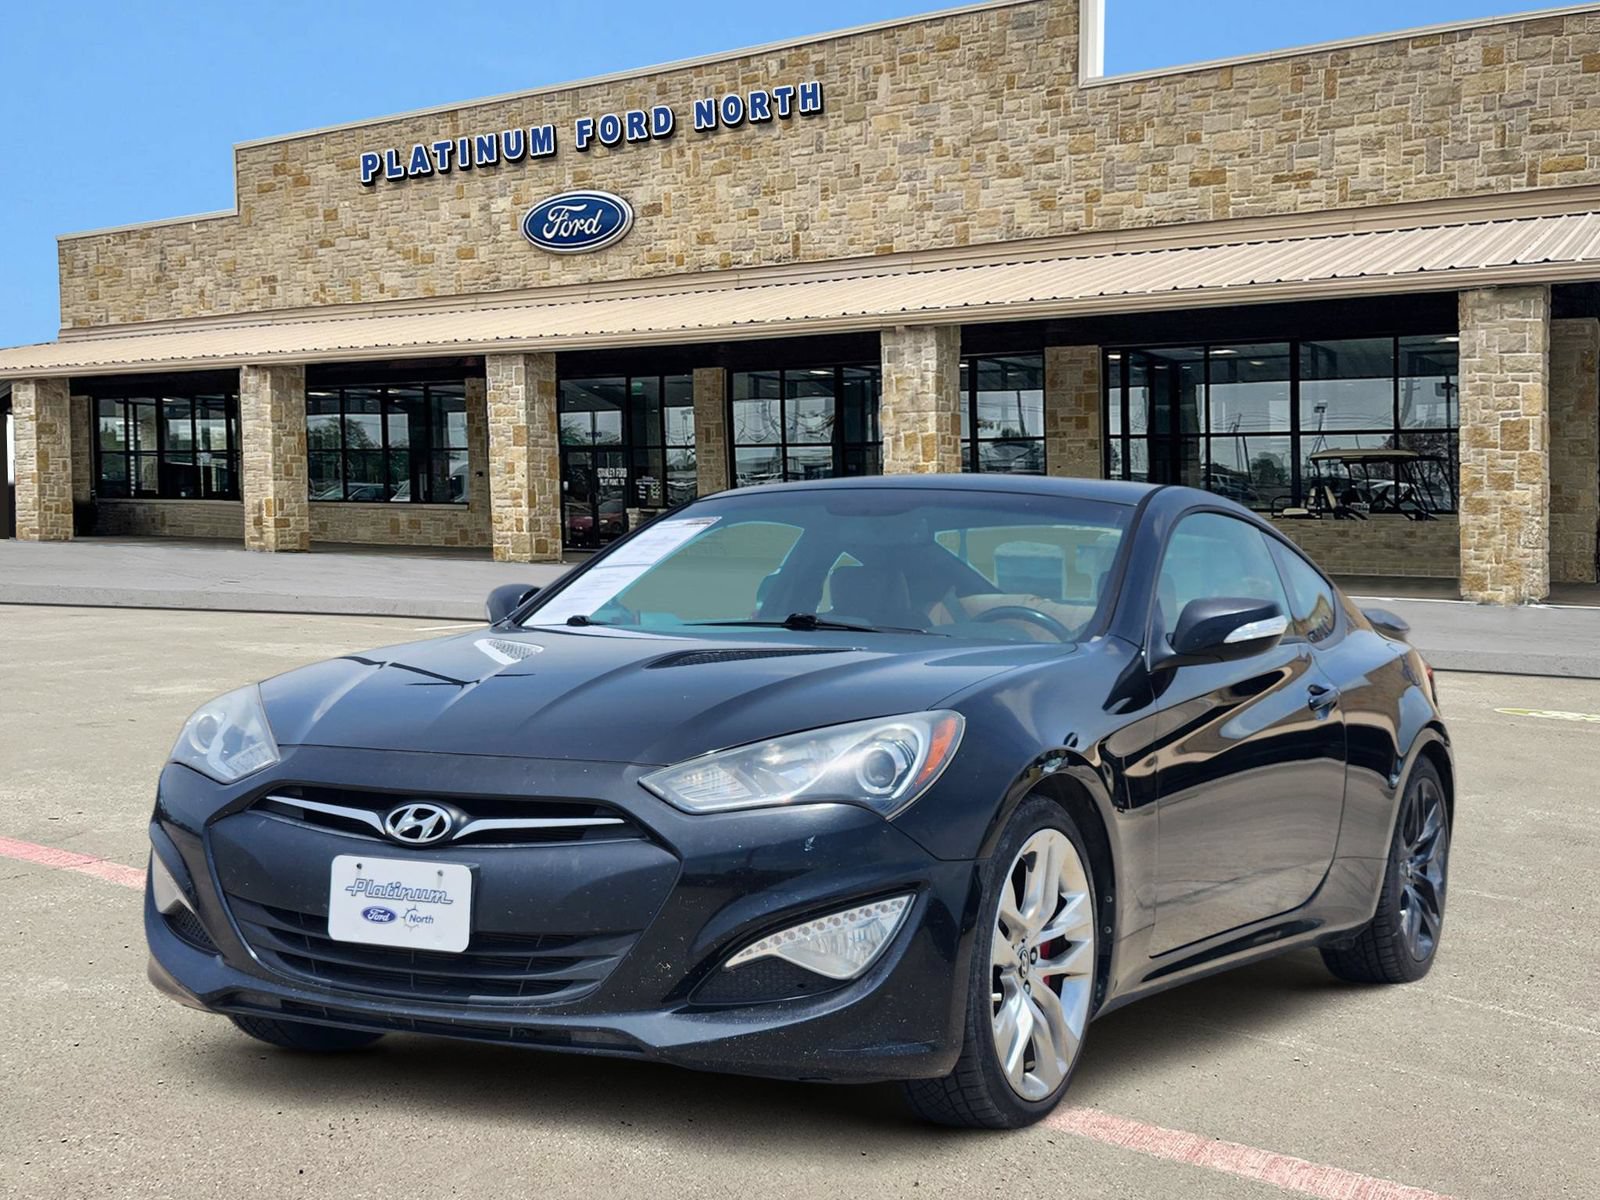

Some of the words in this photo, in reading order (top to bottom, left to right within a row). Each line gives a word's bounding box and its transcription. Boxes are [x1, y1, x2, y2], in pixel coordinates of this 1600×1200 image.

[359, 123, 557, 185] PLATINUM
[575, 105, 675, 151] FORD
[693, 81, 823, 131] NORTH
[542, 203, 603, 240] Ford
[345, 878, 453, 904] Platinum
[367, 908, 390, 922] Ford
[409, 914, 434, 924] North
